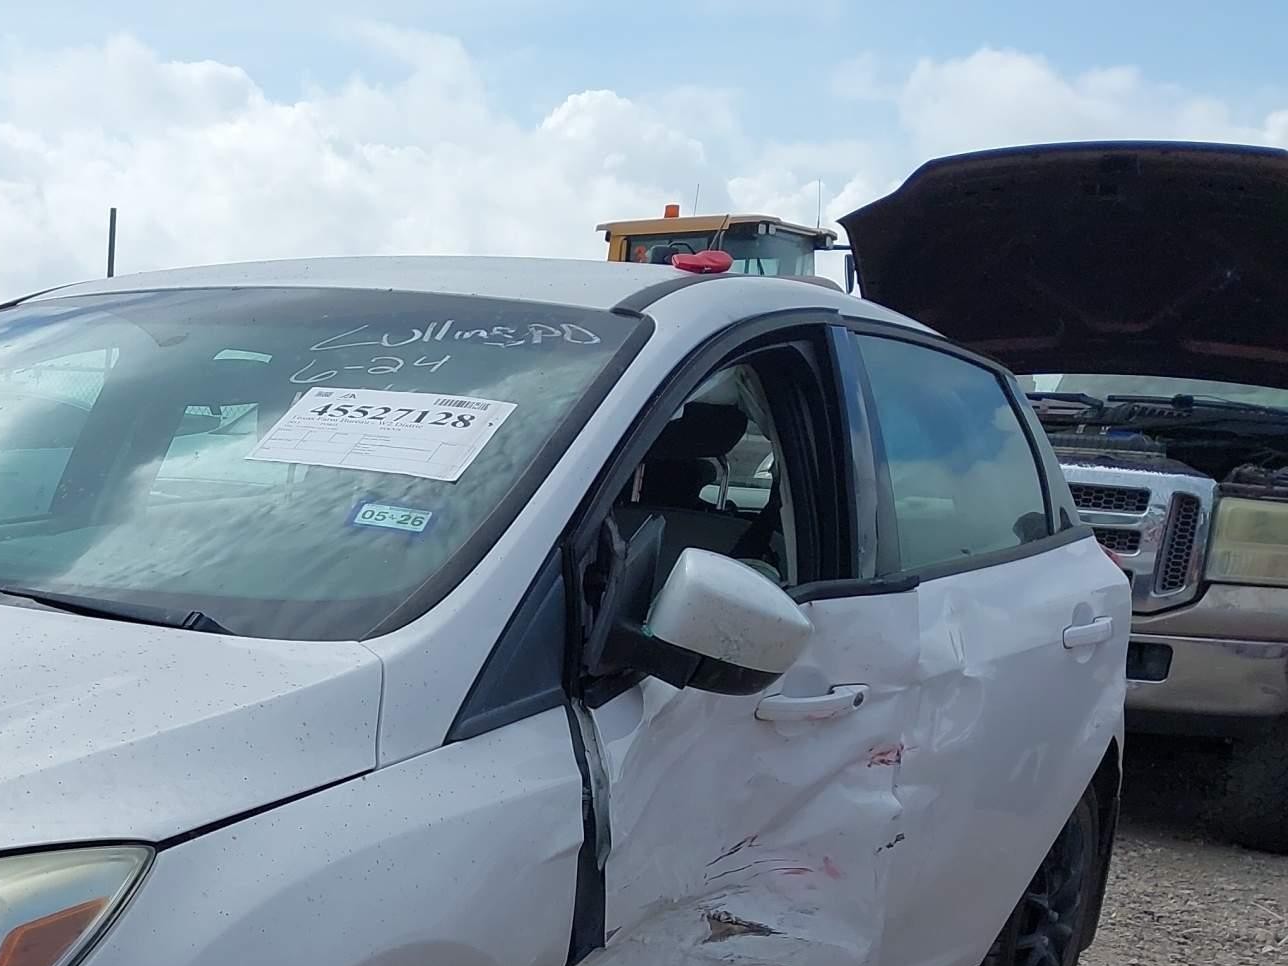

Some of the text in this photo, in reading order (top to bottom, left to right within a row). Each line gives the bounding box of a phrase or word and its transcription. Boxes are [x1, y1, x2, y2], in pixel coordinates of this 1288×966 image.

[289, 355, 451, 383] 6-24
[310, 403, 476, 428] 45527128
[362, 510, 425, 526] 05 26
